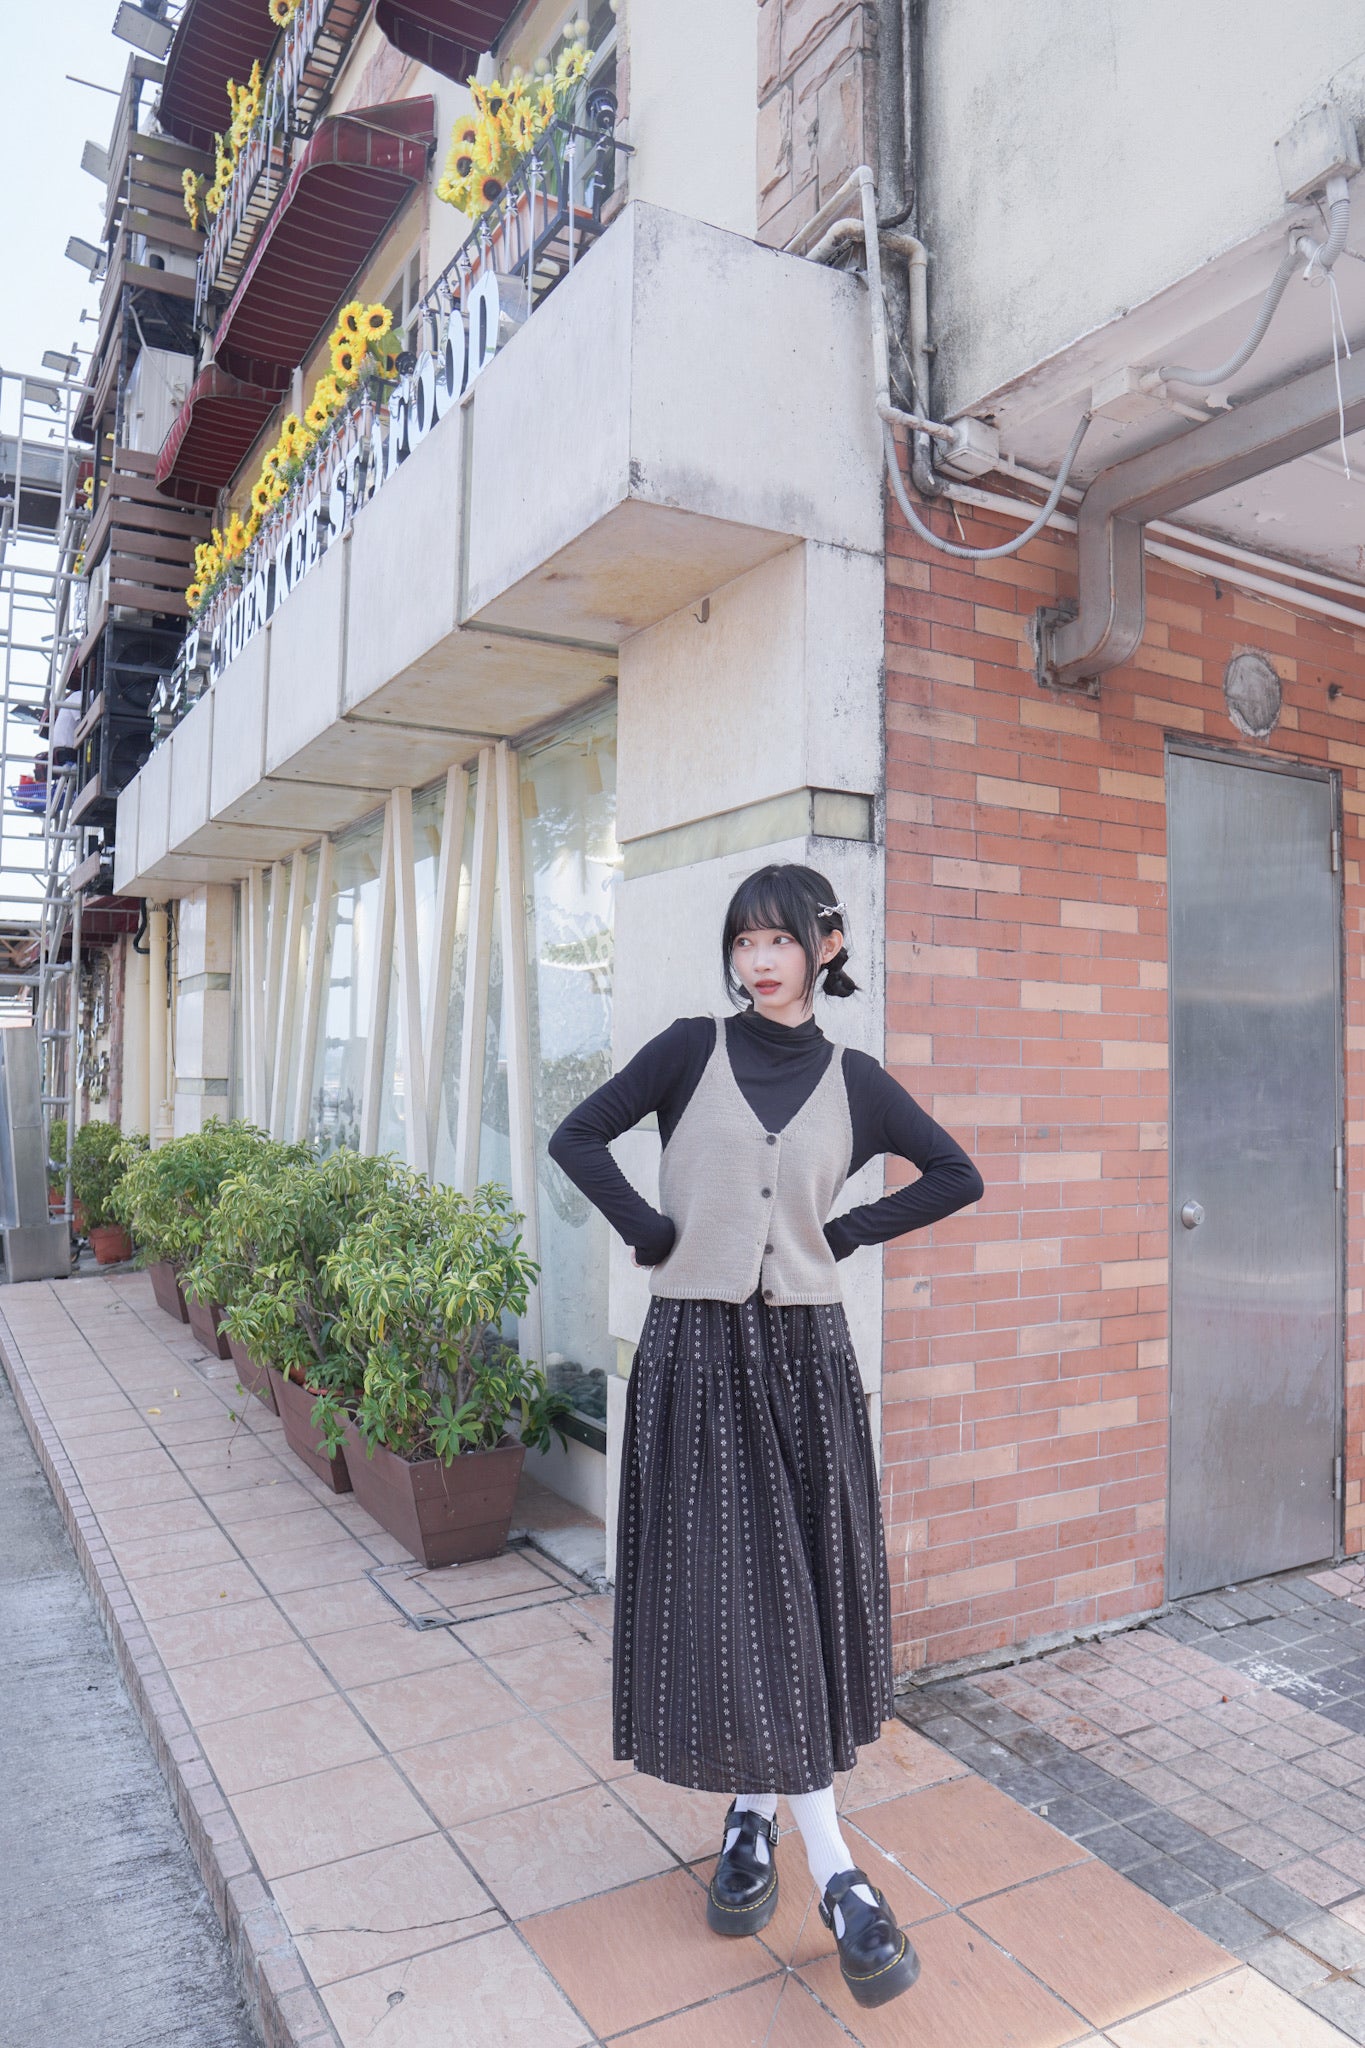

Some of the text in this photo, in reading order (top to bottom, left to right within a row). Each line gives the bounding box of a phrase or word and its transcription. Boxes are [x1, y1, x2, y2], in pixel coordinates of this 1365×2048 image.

[210, 270, 500, 686] CHUEN KEE SEAFOOD
